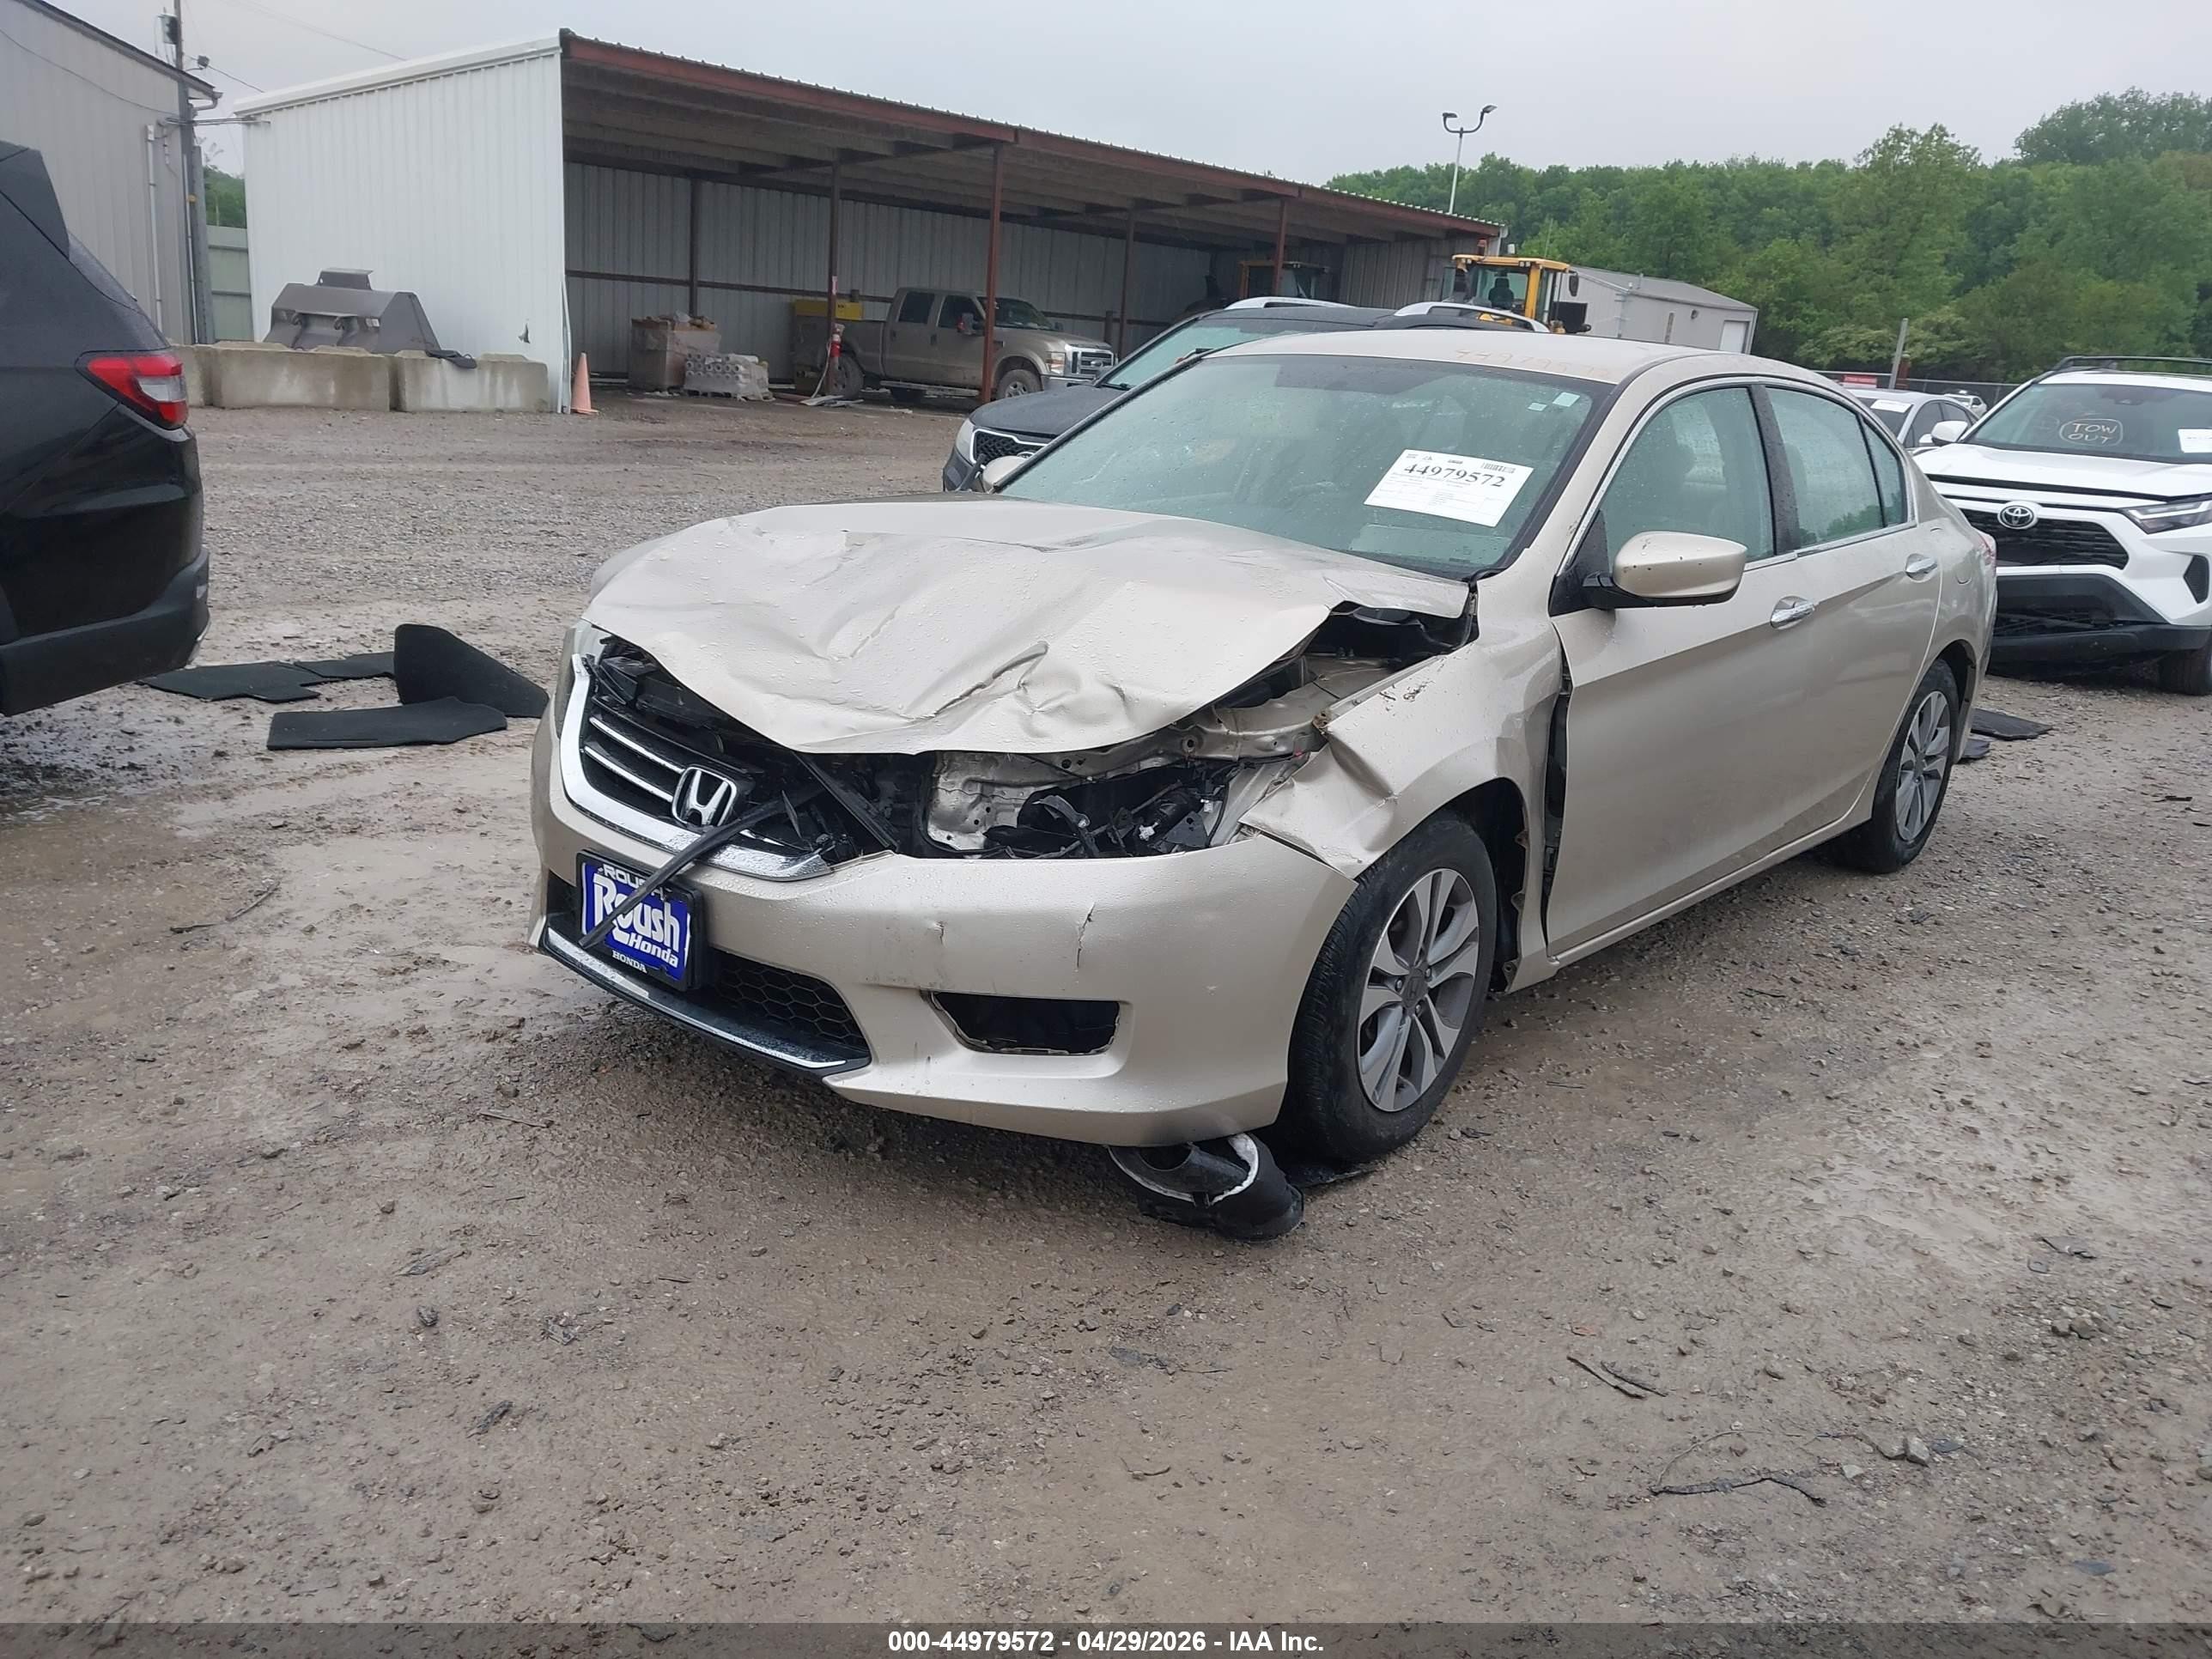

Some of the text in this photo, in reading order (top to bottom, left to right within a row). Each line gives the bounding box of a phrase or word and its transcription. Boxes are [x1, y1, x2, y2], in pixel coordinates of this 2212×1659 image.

[2068, 433, 2112, 444] OUT
[2072, 422, 2118, 434] TOW
[1404, 463, 1505, 488] 44979572
[592, 872, 680, 953] Roush
[612, 949, 647, 974] HONDA
[629, 932, 678, 969] Honda
